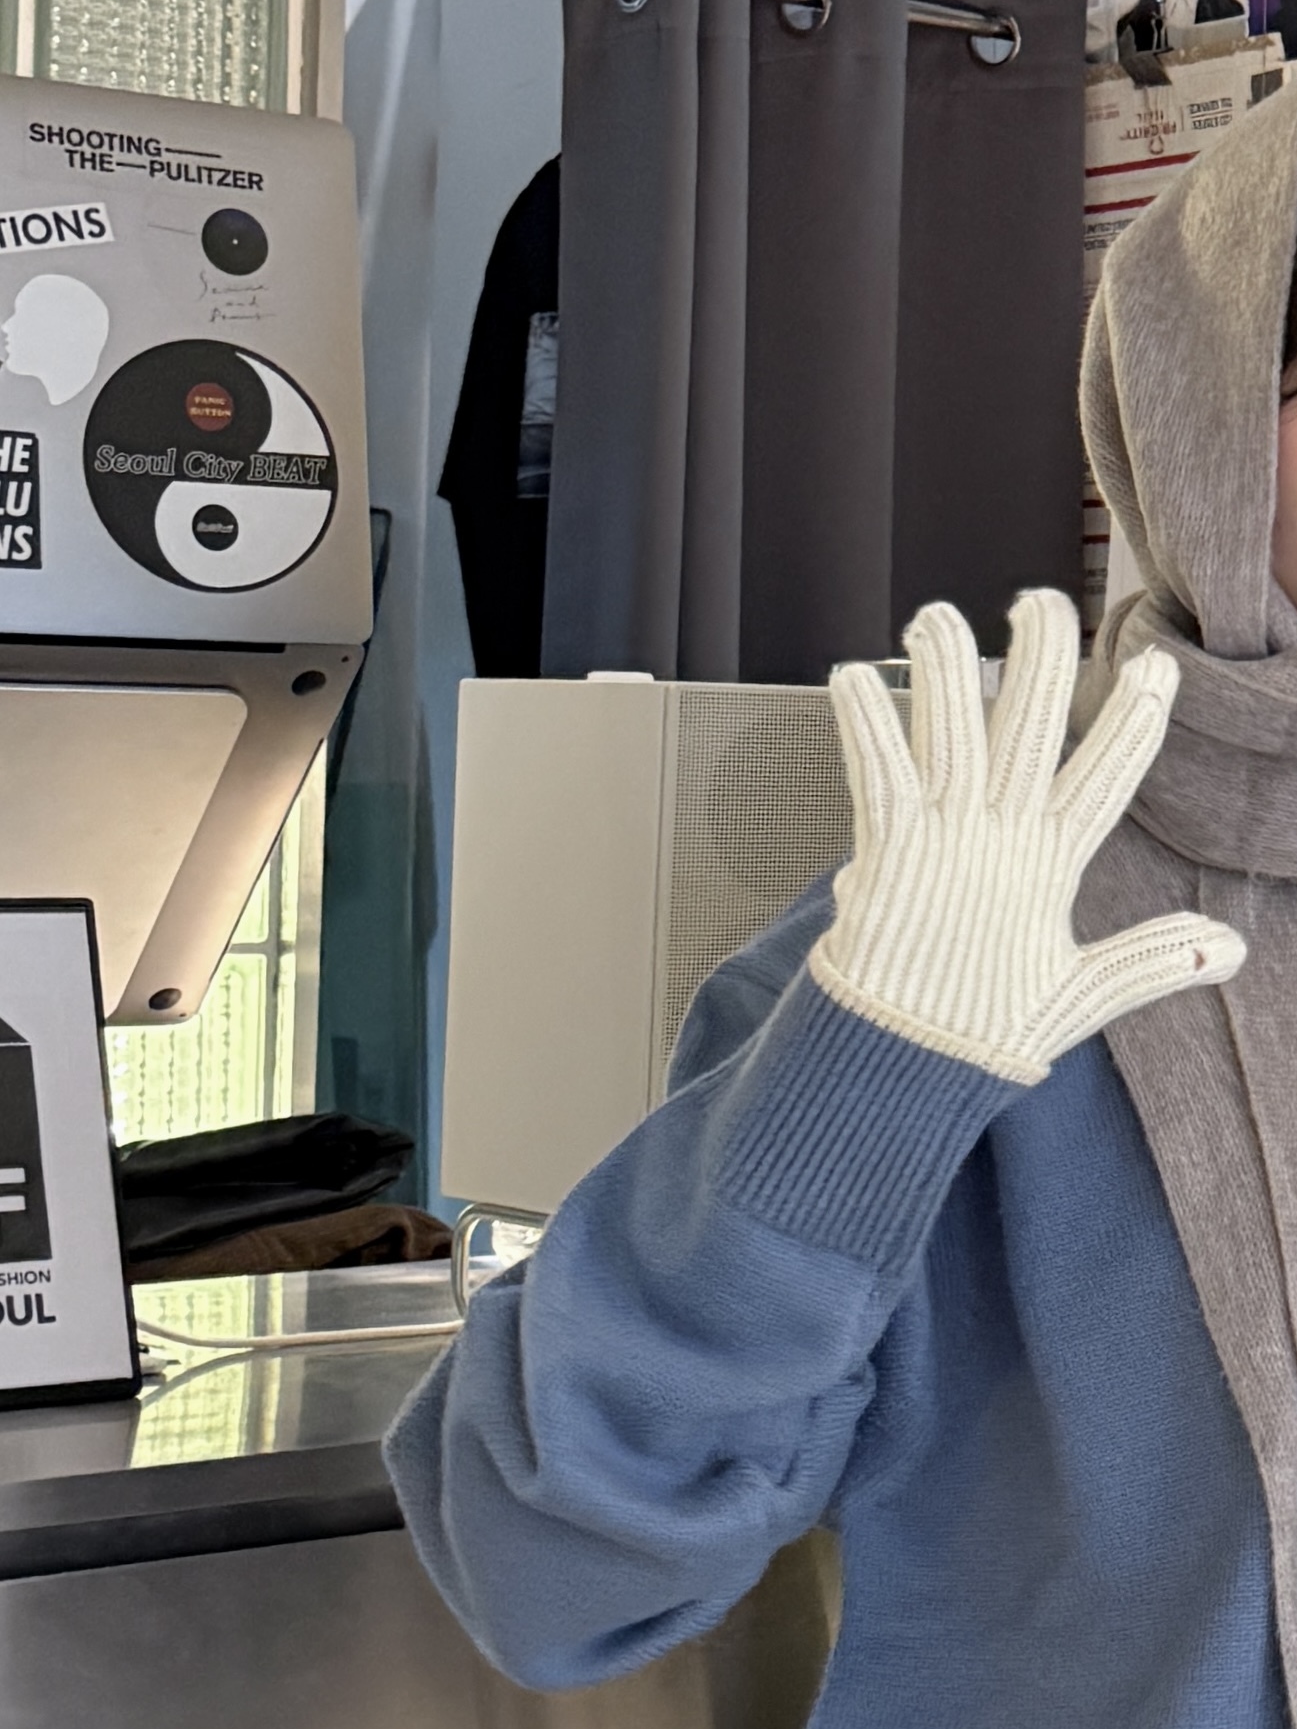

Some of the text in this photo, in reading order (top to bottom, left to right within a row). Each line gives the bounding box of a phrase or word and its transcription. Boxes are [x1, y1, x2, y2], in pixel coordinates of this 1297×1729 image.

[29, 123, 163, 157] SHOOTING
[64, 148, 264, 191] THE PULITZER
[189, 406, 232, 418] BUTTON
[193, 395, 227, 406] PANIC
[94, 444, 328, 486] Seoul City BEAT
[0, 480, 33, 517] U
[0, 1292, 57, 1326] UL
